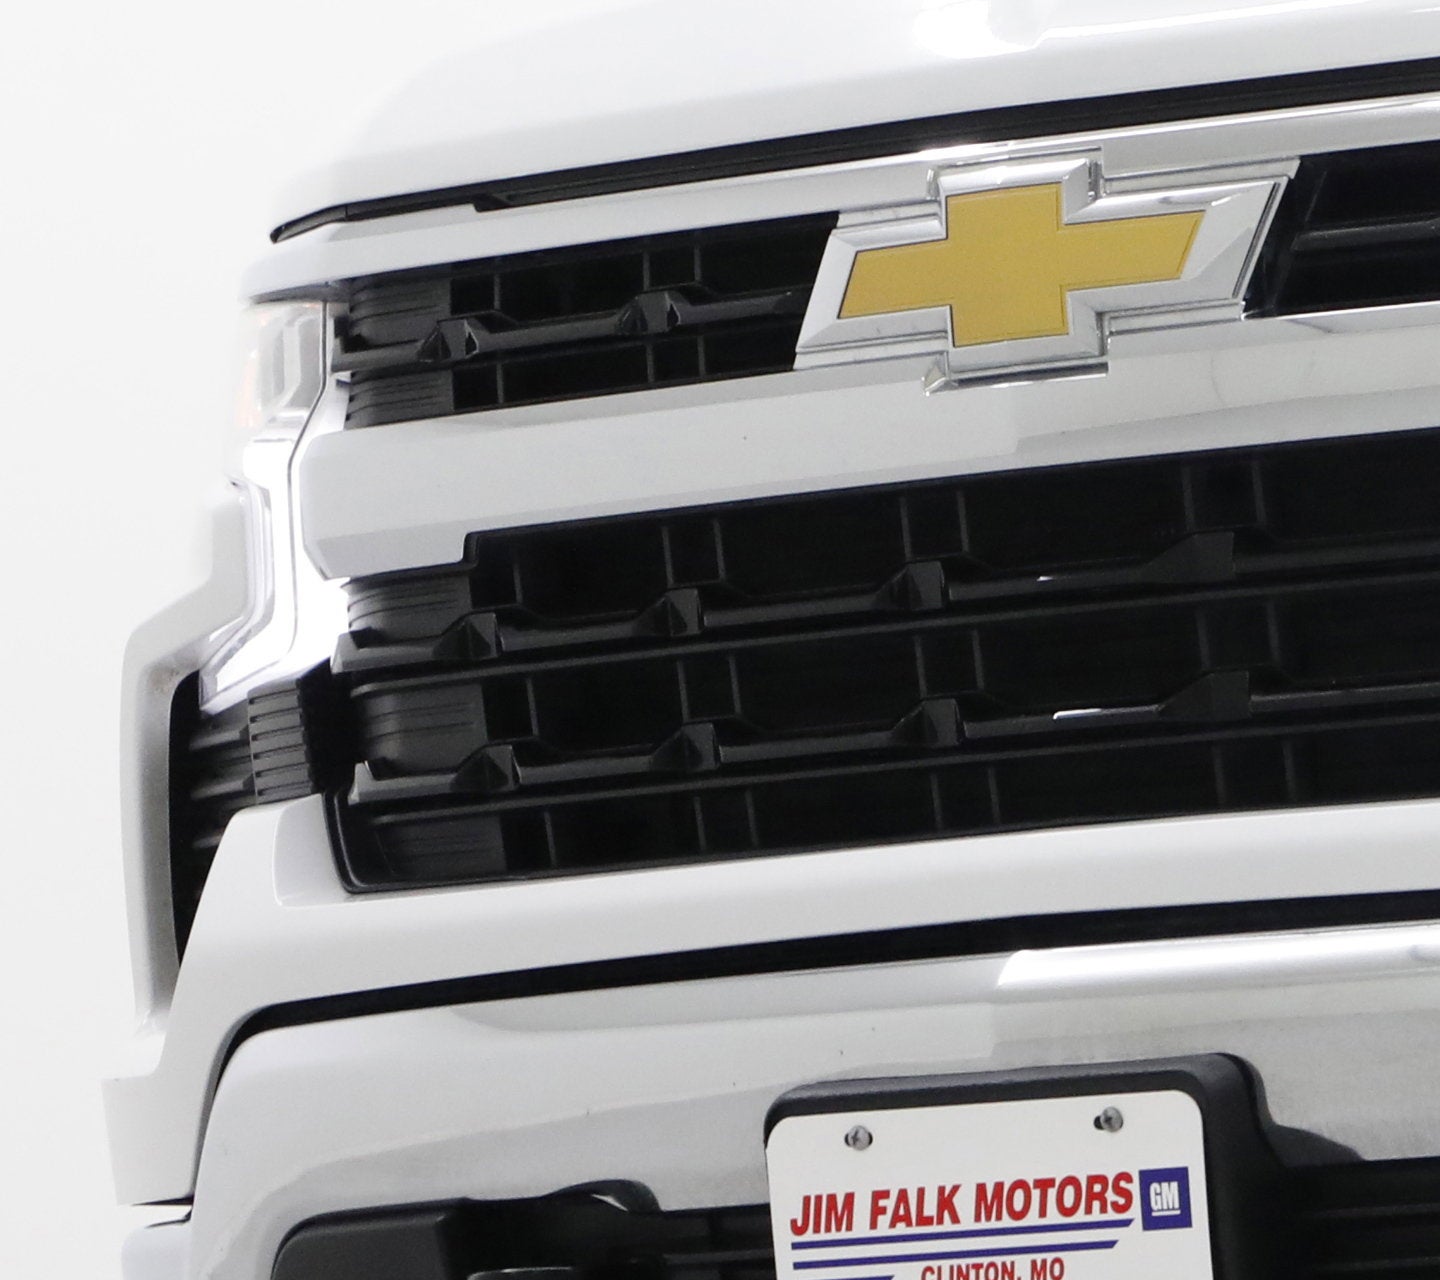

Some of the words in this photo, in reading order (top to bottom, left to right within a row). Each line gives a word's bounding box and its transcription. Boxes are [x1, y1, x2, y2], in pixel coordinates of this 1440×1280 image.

[790, 1193, 855, 1236] JIM
[869, 1184, 961, 1230] FALK
[974, 1171, 1135, 1223] MOTORS
[1149, 1181, 1180, 1211] GM
